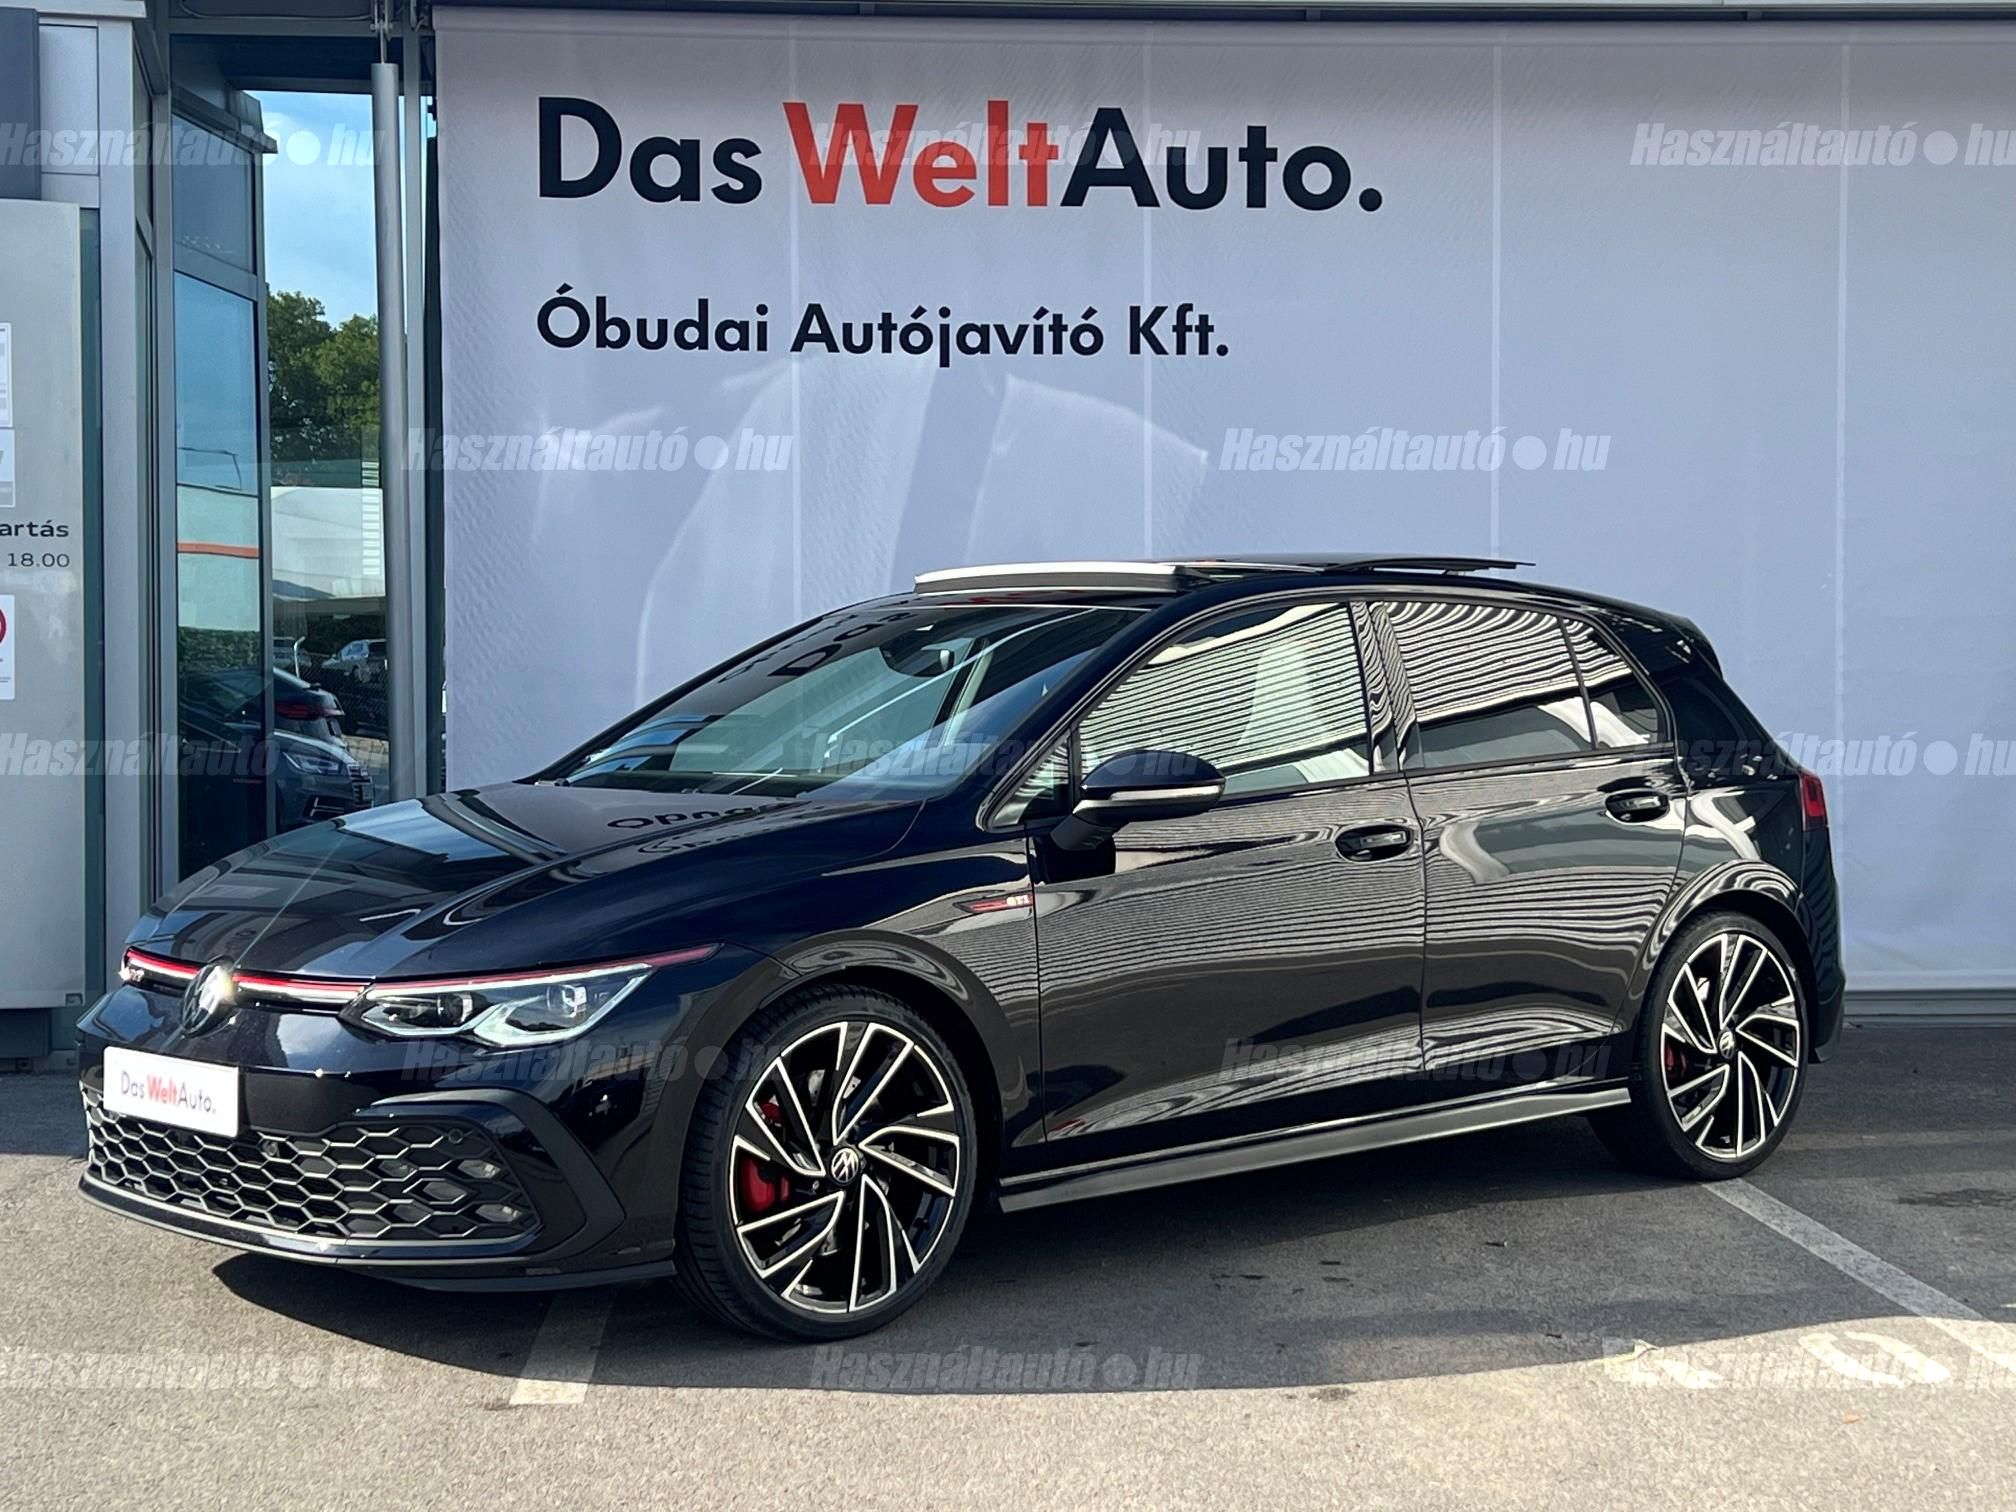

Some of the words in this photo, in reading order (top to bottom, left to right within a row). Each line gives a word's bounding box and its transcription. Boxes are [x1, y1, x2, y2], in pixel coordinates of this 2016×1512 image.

[539, 97, 762, 203] Das
[783, 99, 1383, 212] WeltAuto.
[536, 284, 768, 353] Óbudai
[791, 303, 1104, 367] Autójavító
[1128, 304, 1230, 359] Kft.
[7, 553, 71, 568] 18.00
[121, 1070, 145, 1099] Das
